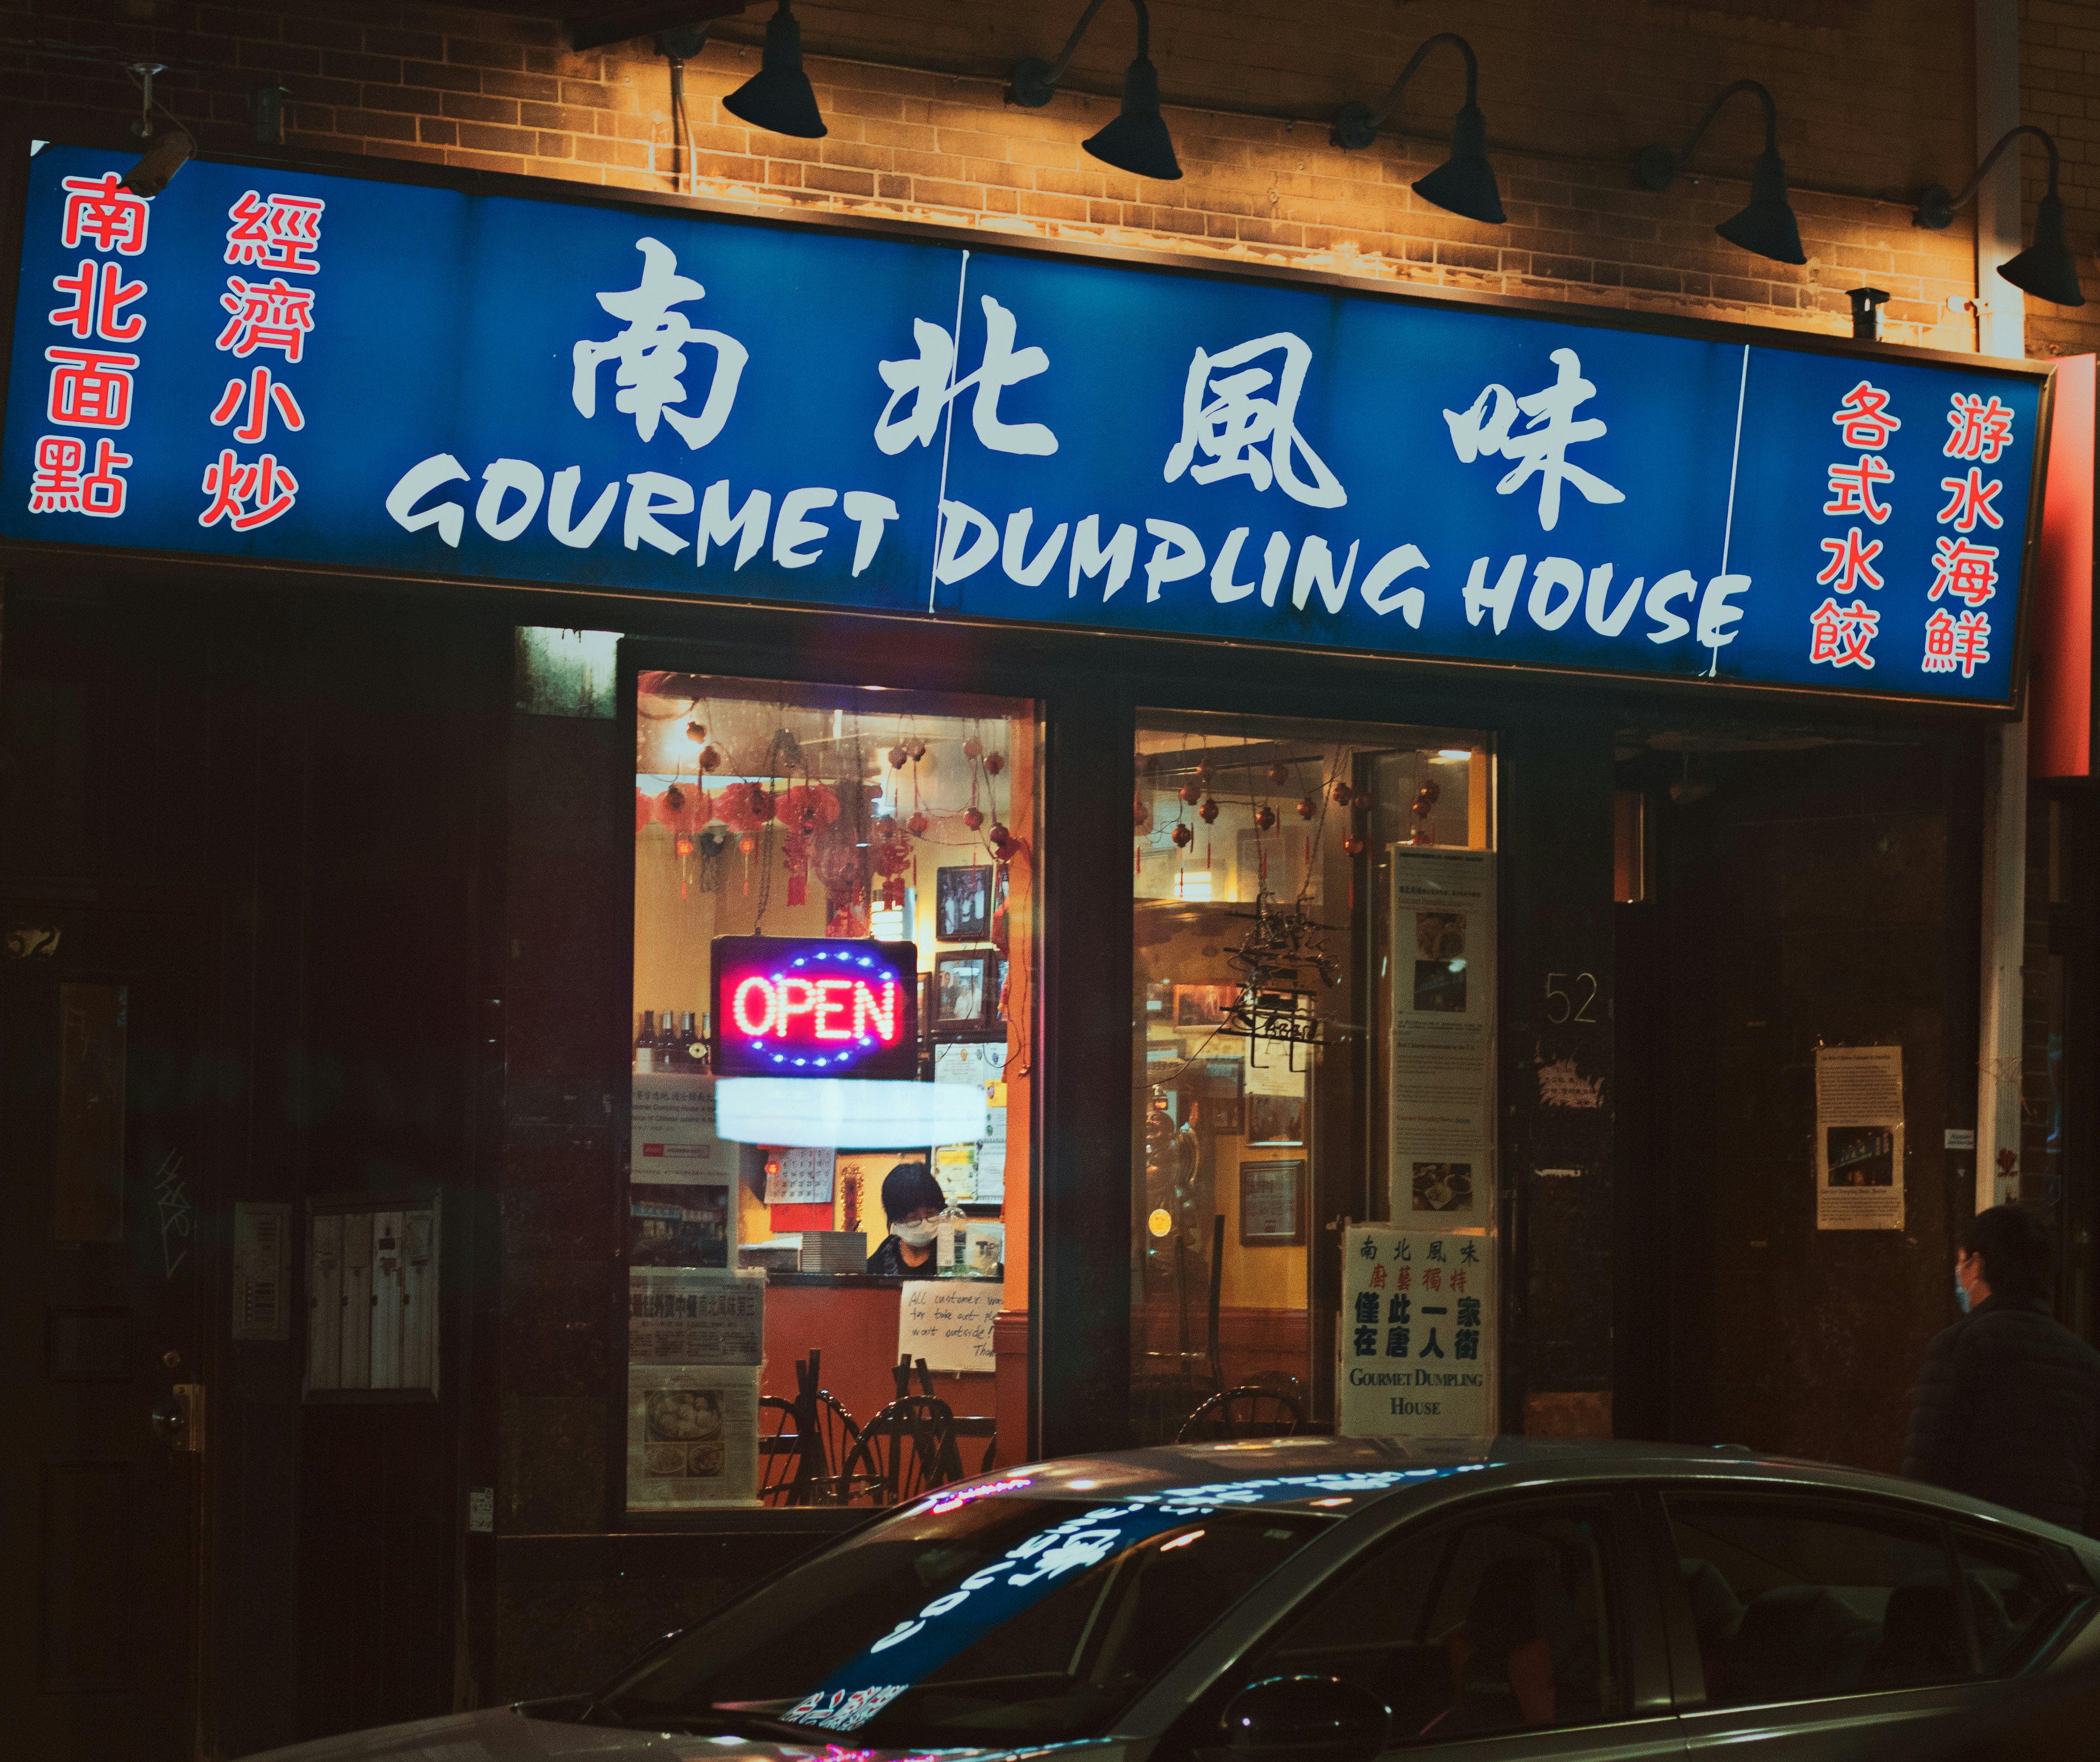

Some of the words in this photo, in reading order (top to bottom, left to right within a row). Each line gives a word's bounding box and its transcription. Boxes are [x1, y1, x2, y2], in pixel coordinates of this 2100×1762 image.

[28, 172, 155, 517] 南北面點
[199, 190, 325, 532] 經濟小炒
[572, 237, 1625, 532] 南北風味
[386, 453, 899, 577] GOURMET
[934, 499, 1431, 629] DUMPLING
[1463, 554, 1751, 647] HOUSE
[1809, 381, 1901, 670] 各式水餃
[1922, 393, 2013, 678] 游水海鮮
[733, 977, 894, 1041] OPEN
[1545, 972, 1598, 1024] 52
[1360, 1235, 1480, 1266] 南北風味
[908, 1292, 926, 1306] All
[935, 1291, 981, 1305] customer
[957, 1309, 979, 1320] out
[1354, 1292, 1481, 1327] 僅此一家
[1353, 1325, 1480, 1360] 在唐人街
